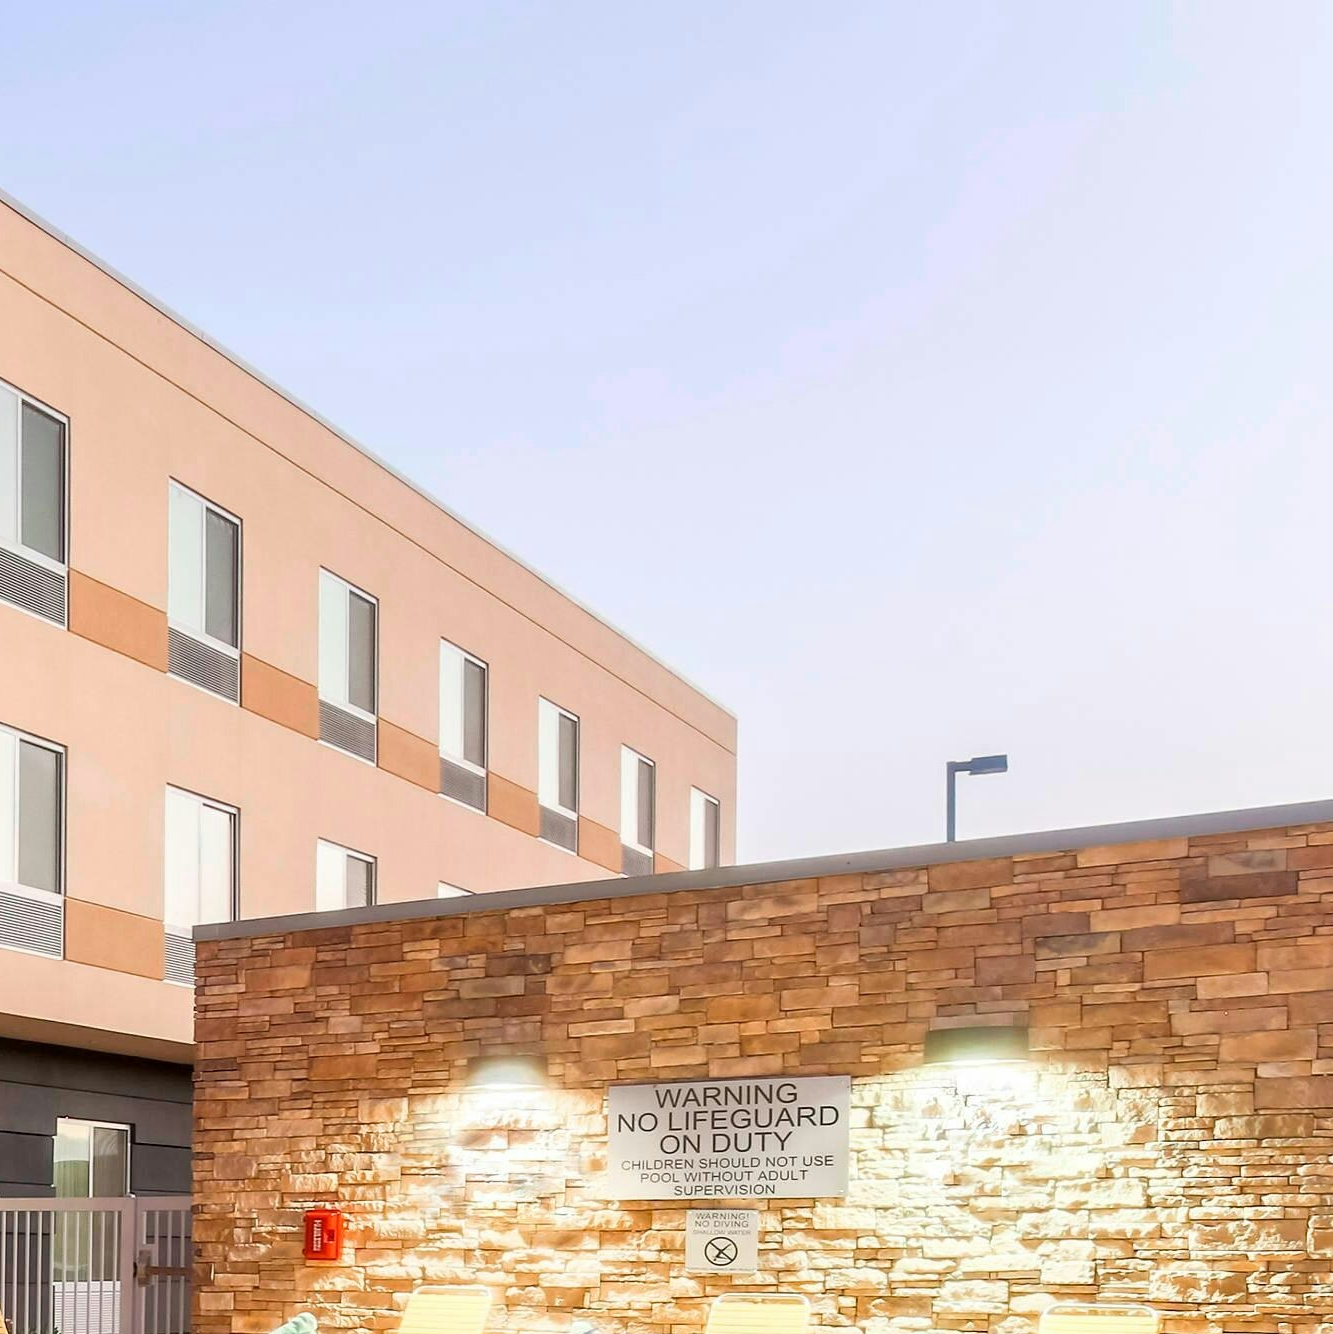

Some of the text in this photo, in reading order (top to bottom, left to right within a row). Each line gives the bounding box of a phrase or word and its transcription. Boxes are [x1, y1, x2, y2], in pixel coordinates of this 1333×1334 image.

[655, 1083, 798, 1108] WARNING
[618, 1105, 839, 1132] NO LIFEGUARD
[659, 1130, 793, 1154] ON DUTY
[621, 1155, 834, 1170] CHILDREN SHOULD NOT USE
[640, 1169, 808, 1183] POOL WITHOUT ADULT
[674, 1184, 775, 1196] SUPERVISION
[695, 1212, 750, 1220] WARNING!
[694, 1220, 749, 1228] NO DIVING
